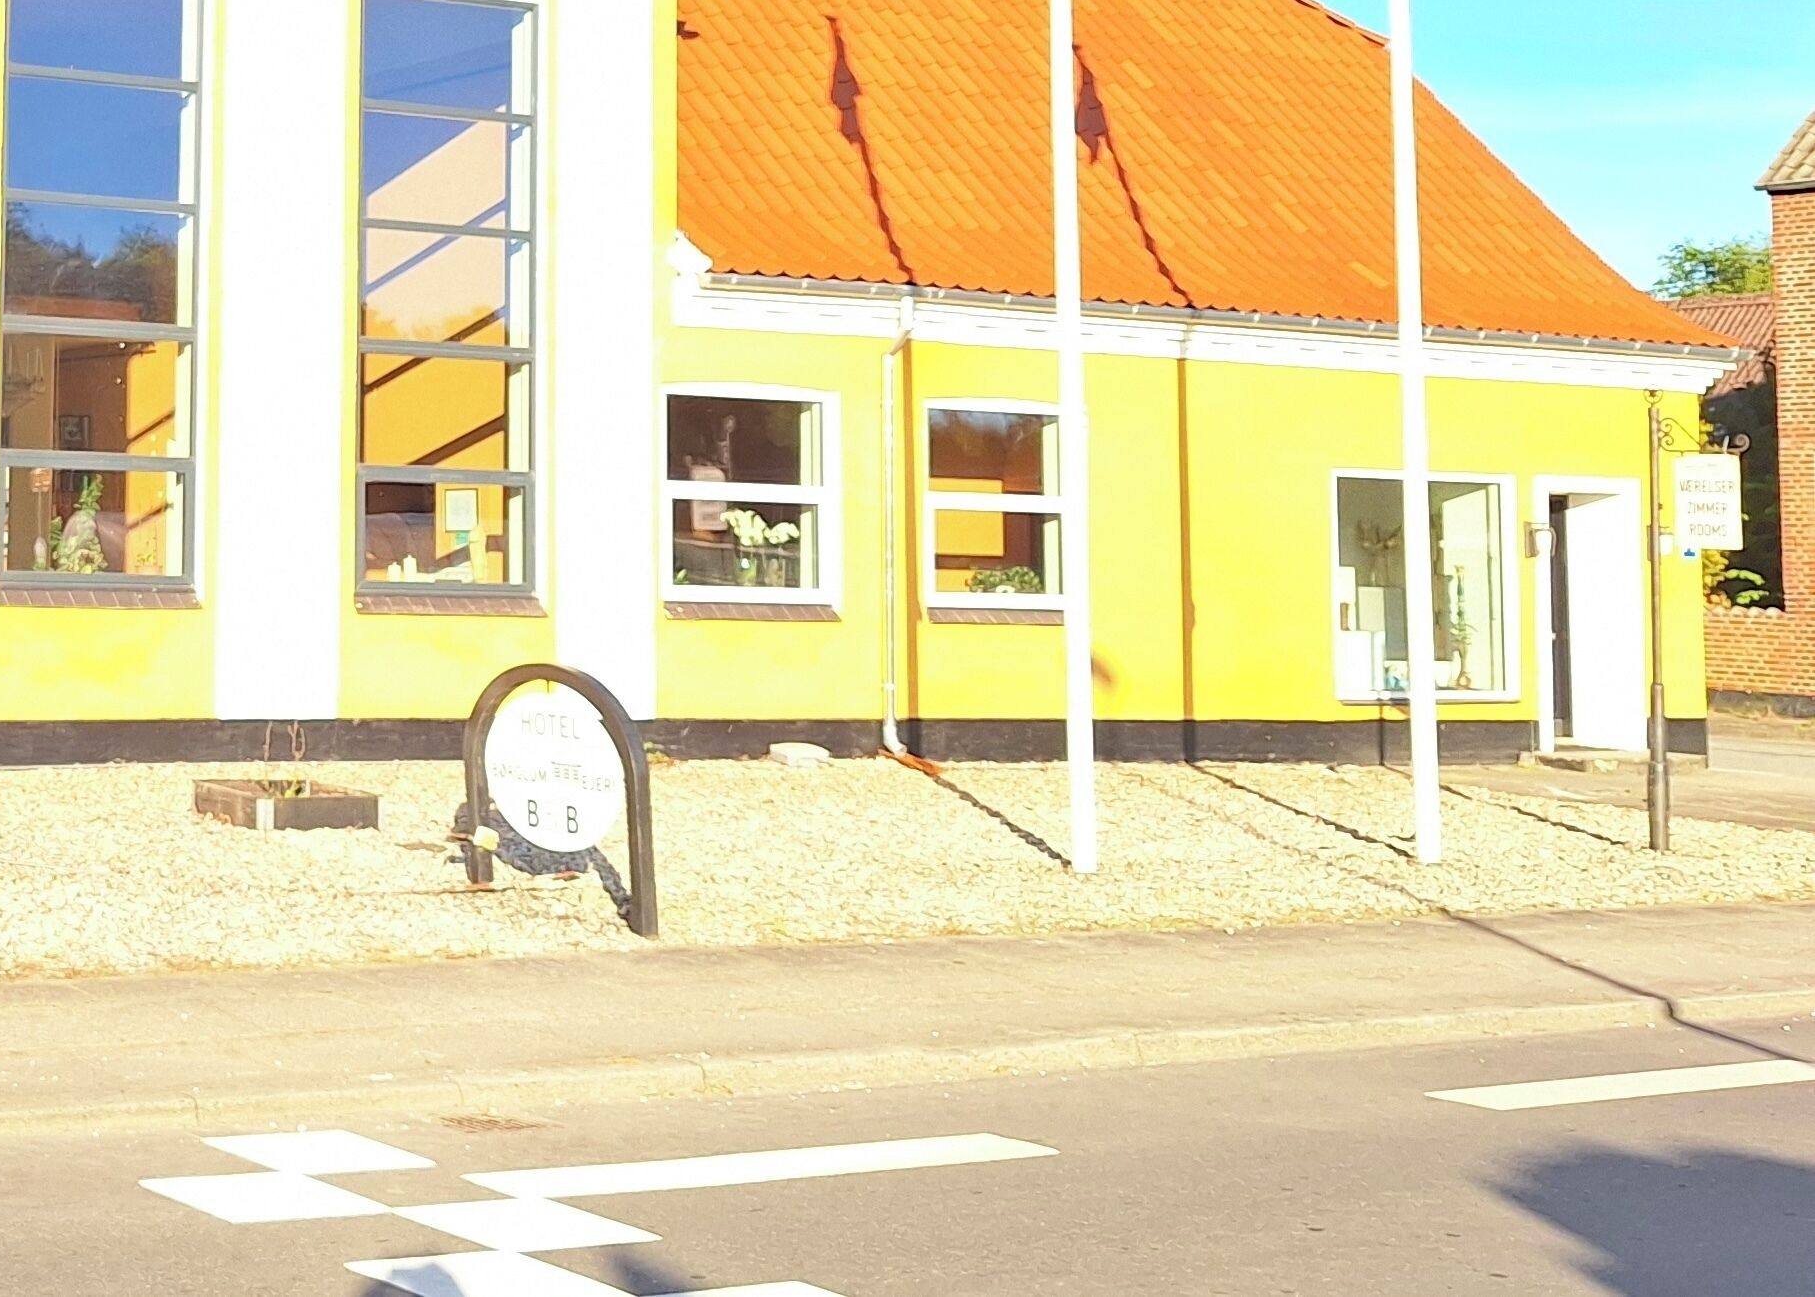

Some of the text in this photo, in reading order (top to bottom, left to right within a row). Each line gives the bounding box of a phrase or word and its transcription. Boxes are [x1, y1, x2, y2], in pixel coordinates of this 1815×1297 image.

[1687, 501, 1728, 515] ZIMMER
[1689, 523, 1727, 537] ROOMS
[521, 712, 581, 740] HOTEL
[527, 799, 540, 827] B
[566, 805, 579, 834] B
